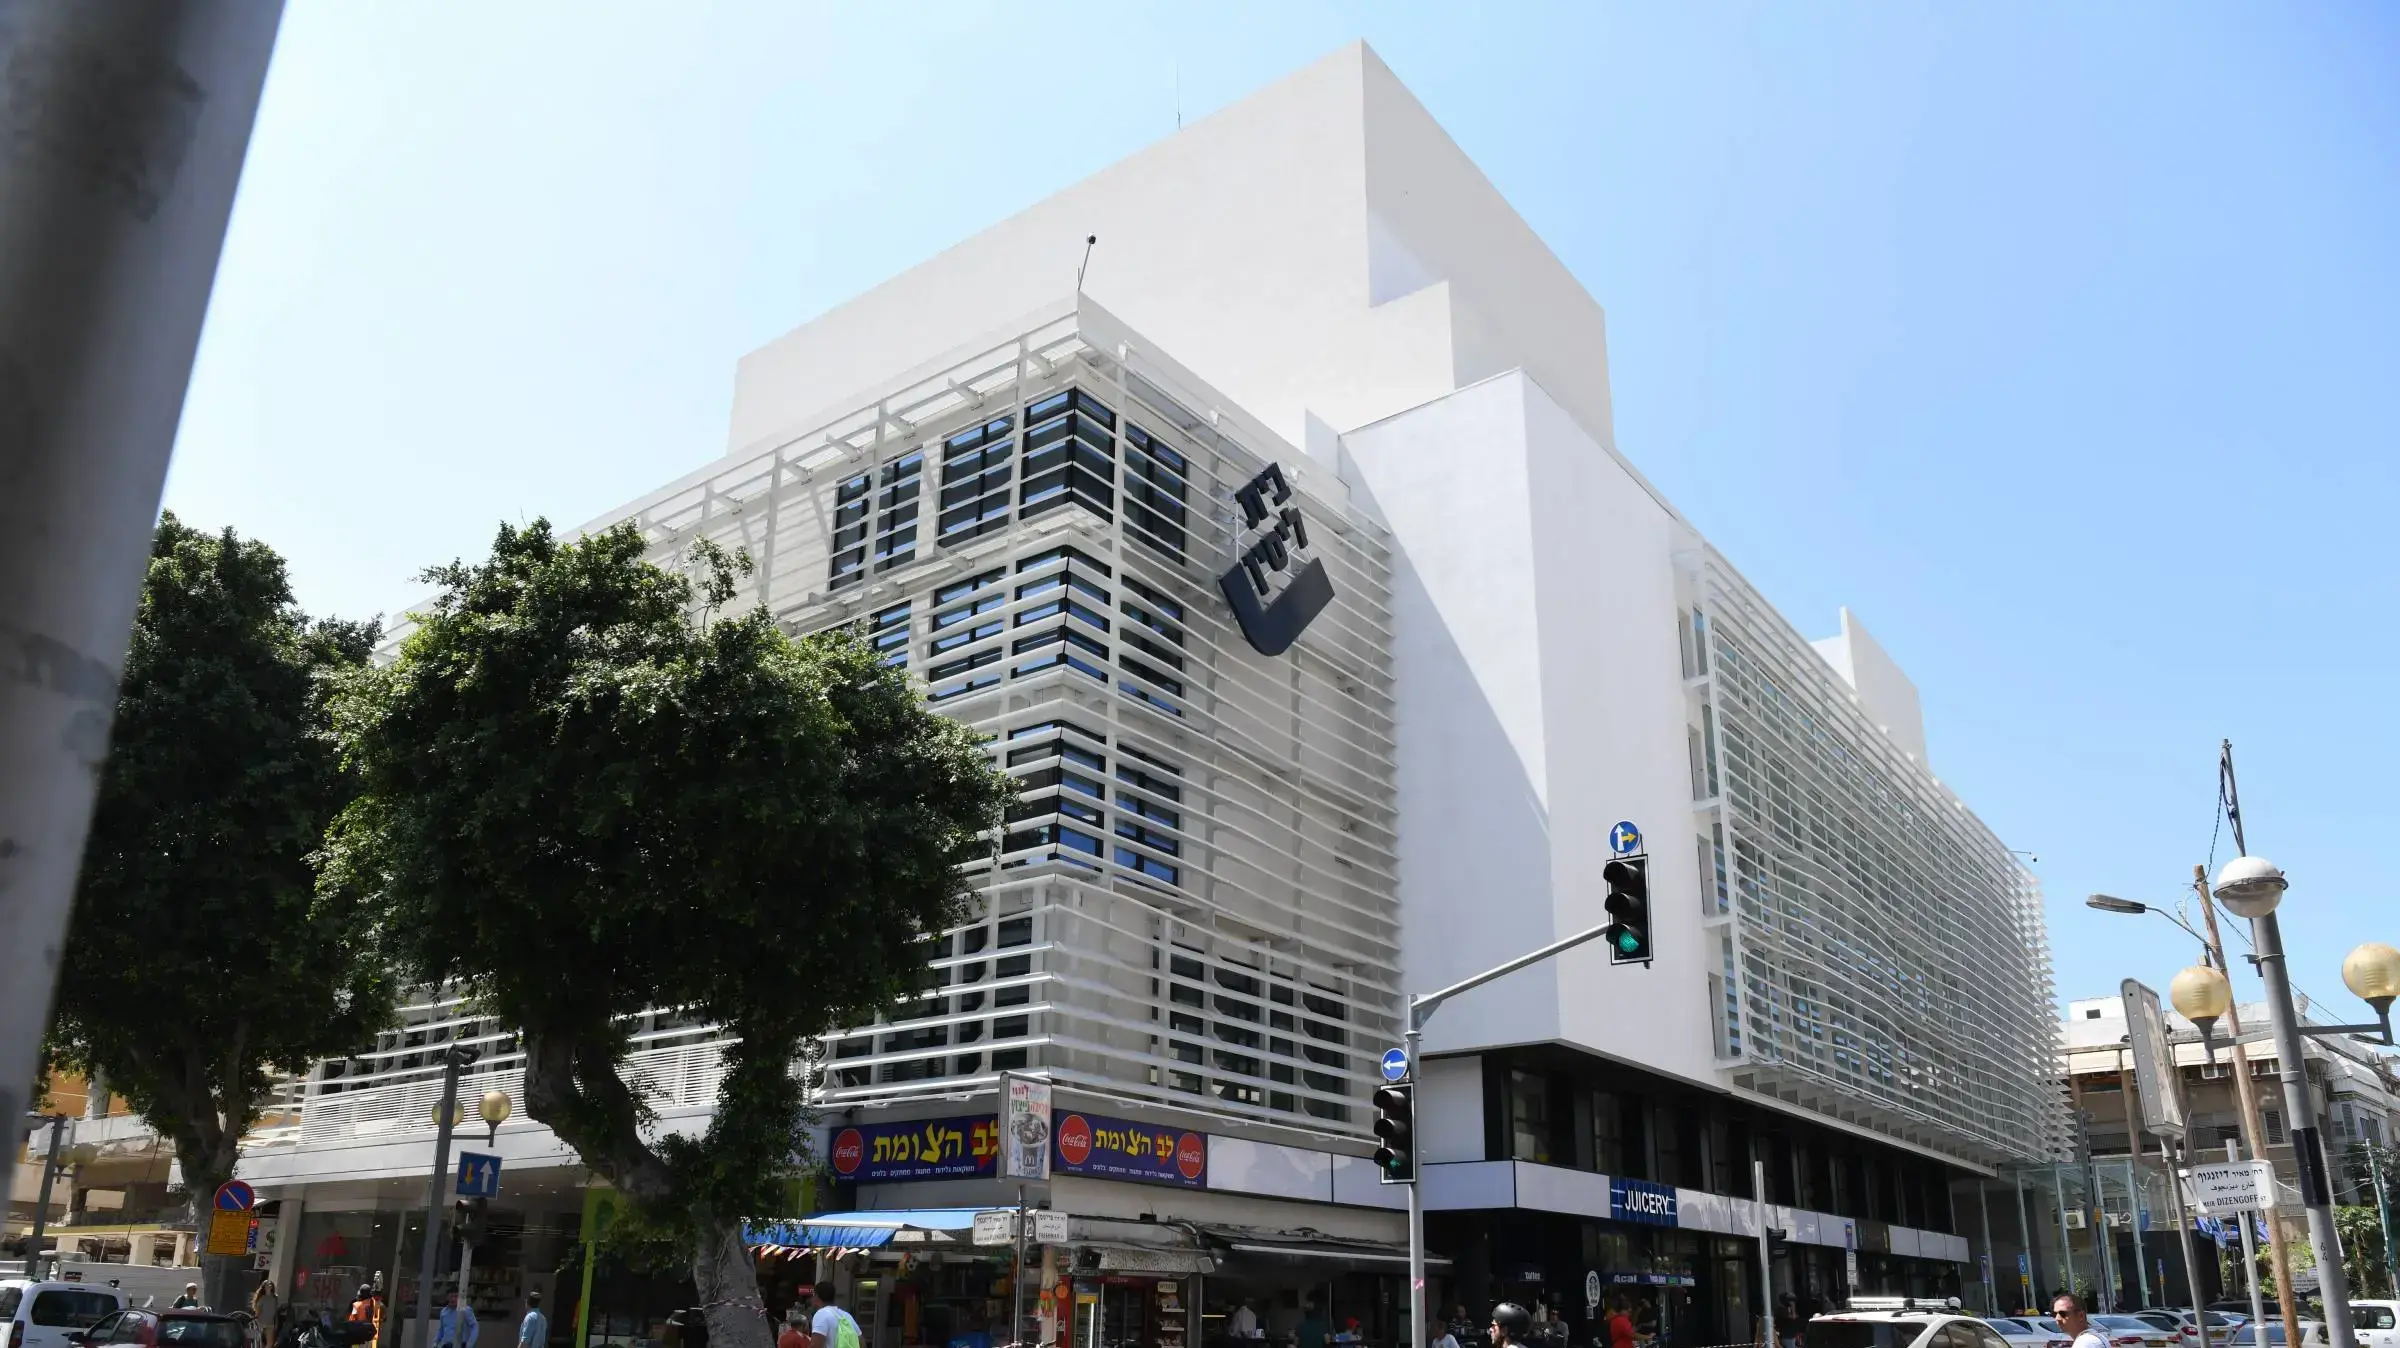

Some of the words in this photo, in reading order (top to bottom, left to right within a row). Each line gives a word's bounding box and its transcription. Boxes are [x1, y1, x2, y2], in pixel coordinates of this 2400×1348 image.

[1235, 461, 1292, 530] בית
[1241, 507, 1309, 596] ליסין
[872, 1122, 962, 1163] הצומת
[1062, 1132, 1088, 1148] Coca-Cola
[1095, 1128, 1151, 1156] הצומת
[1156, 1135, 1174, 1158] לב
[835, 1144, 859, 1158] Coca-Cola
[1179, 1150, 1201, 1163] Coca-Cola
[2198, 1169, 2229, 1183] דיזנגוף
[2232, 1169, 2250, 1177] מאיר
[1625, 1190, 1669, 1215] JUICERY
[2216, 1194, 2259, 1206] DIZENGOFF
